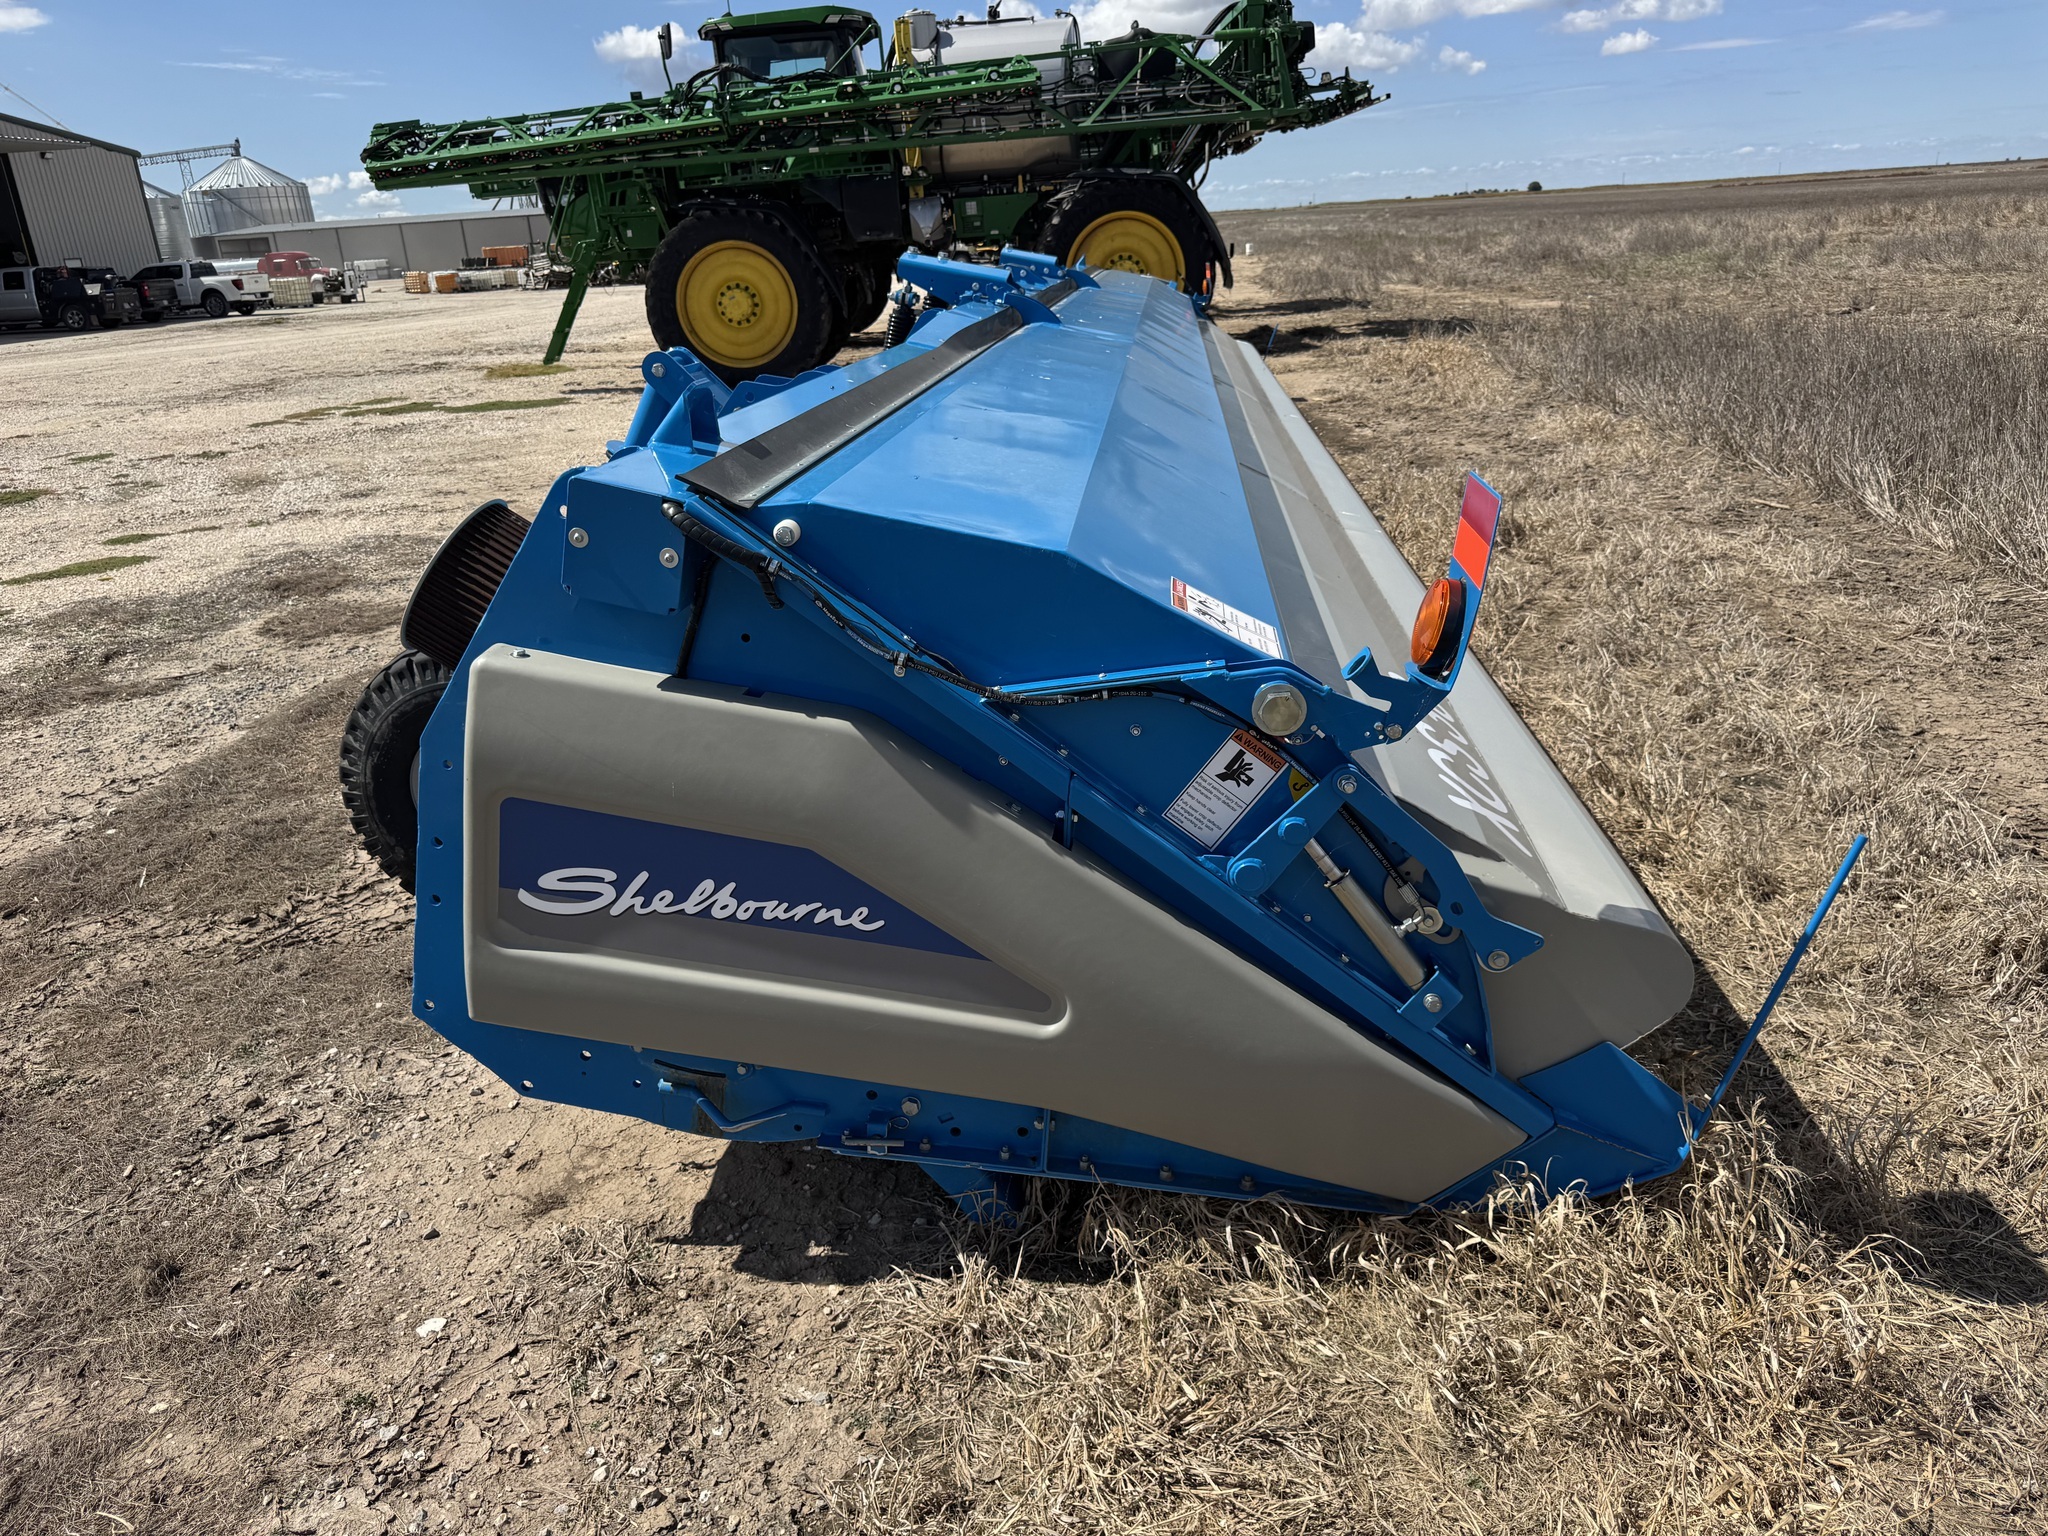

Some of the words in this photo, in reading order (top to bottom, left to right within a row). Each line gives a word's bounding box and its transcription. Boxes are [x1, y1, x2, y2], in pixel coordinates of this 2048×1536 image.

[1244, 738, 1282, 768] WARNING
[1186, 792, 1195, 800] Keep
[1196, 798, 1206, 808] hands
[517, 867, 885, 932] Shelbourne
